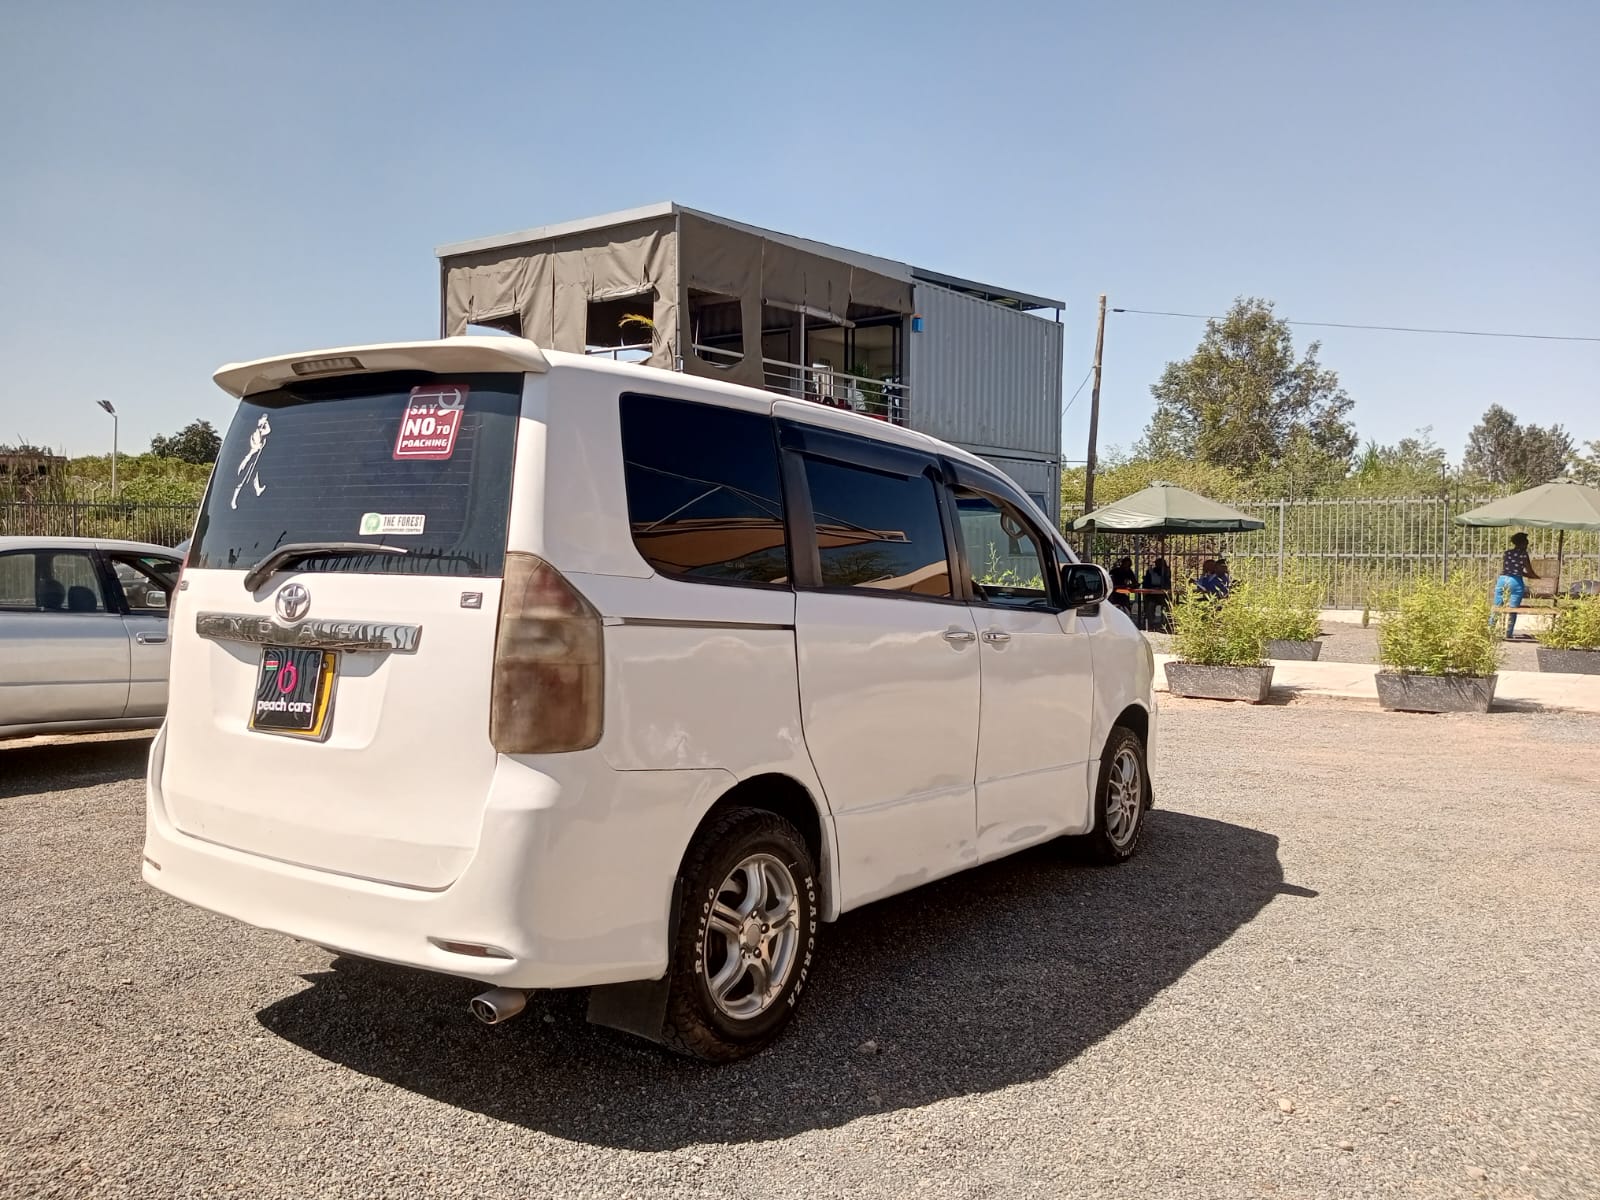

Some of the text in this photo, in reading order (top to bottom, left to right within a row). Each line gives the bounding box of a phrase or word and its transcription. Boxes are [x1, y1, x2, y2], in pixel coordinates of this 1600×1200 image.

[410, 403, 438, 415] SAY
[404, 417, 451, 436] NO TO
[401, 438, 448, 448] POACHING
[383, 516, 424, 527] THE FOREST
[256, 697, 312, 715] peach cars
[787, 875, 818, 1008] ROADCRUZA
